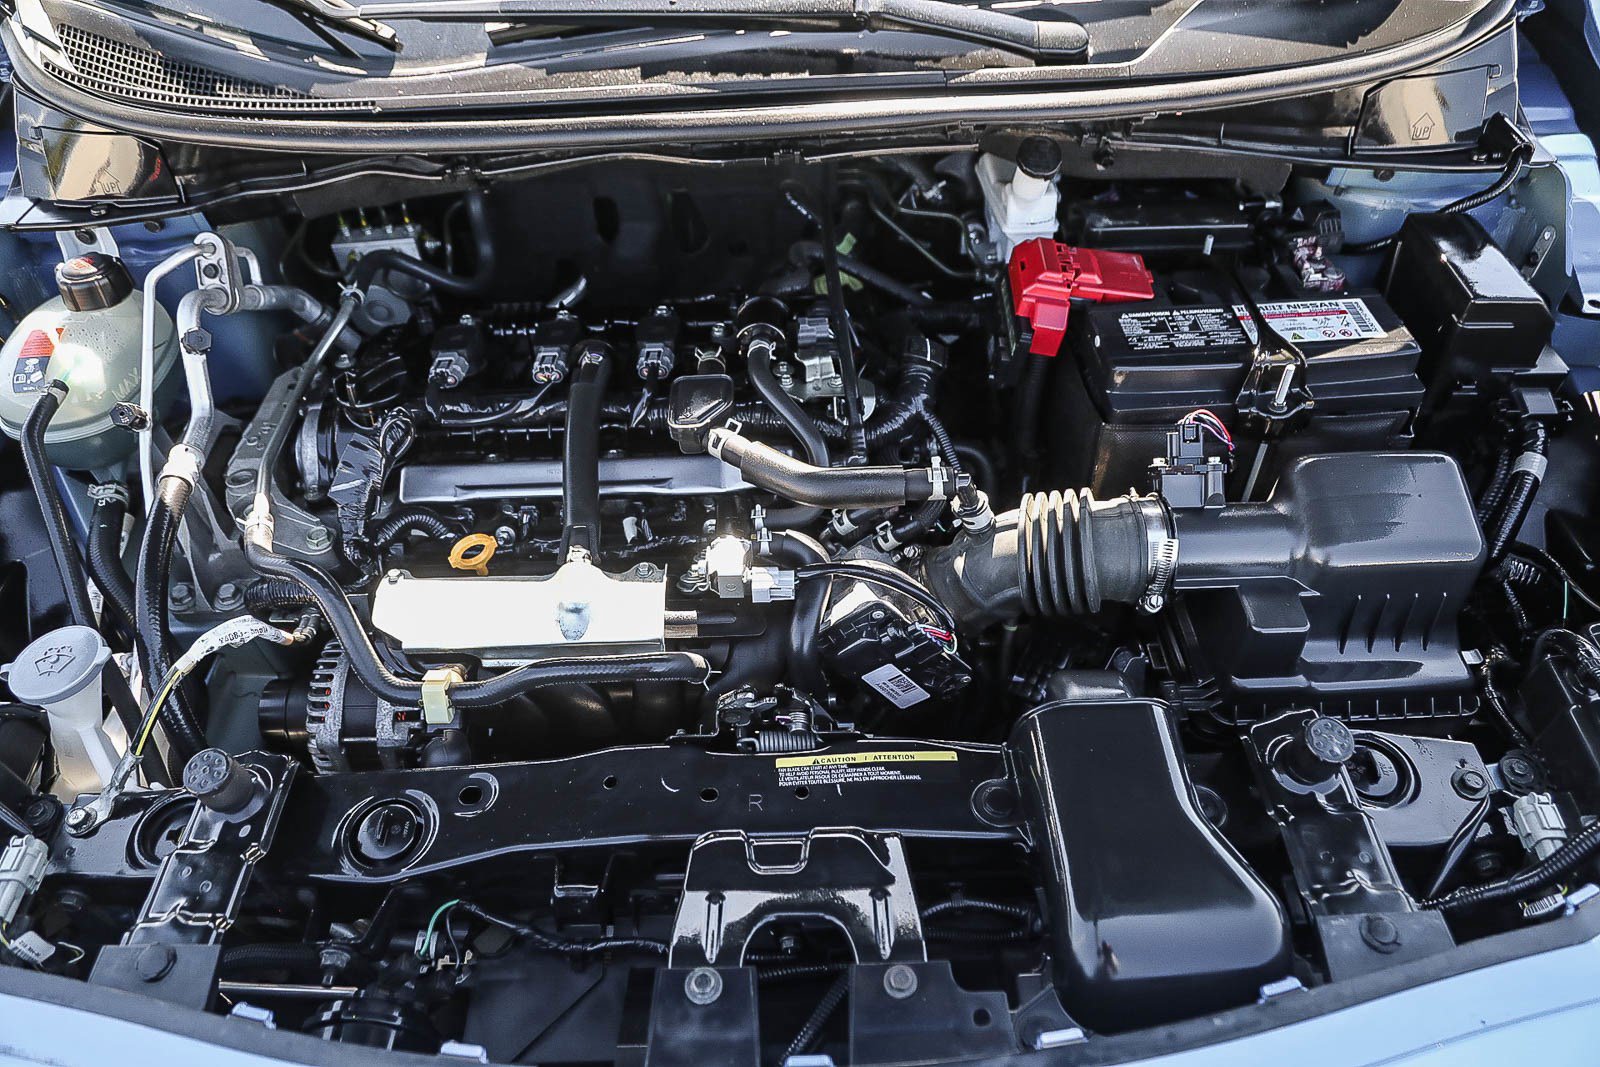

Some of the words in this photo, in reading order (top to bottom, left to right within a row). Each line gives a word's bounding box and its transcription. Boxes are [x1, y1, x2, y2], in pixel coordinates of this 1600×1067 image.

[1414, 126, 1430, 138] UP
[103, 182, 117, 193] UP
[1286, 301, 1340, 310] NISSAN
[111, 367, 139, 401] MAX
[749, 793, 763, 812] R
